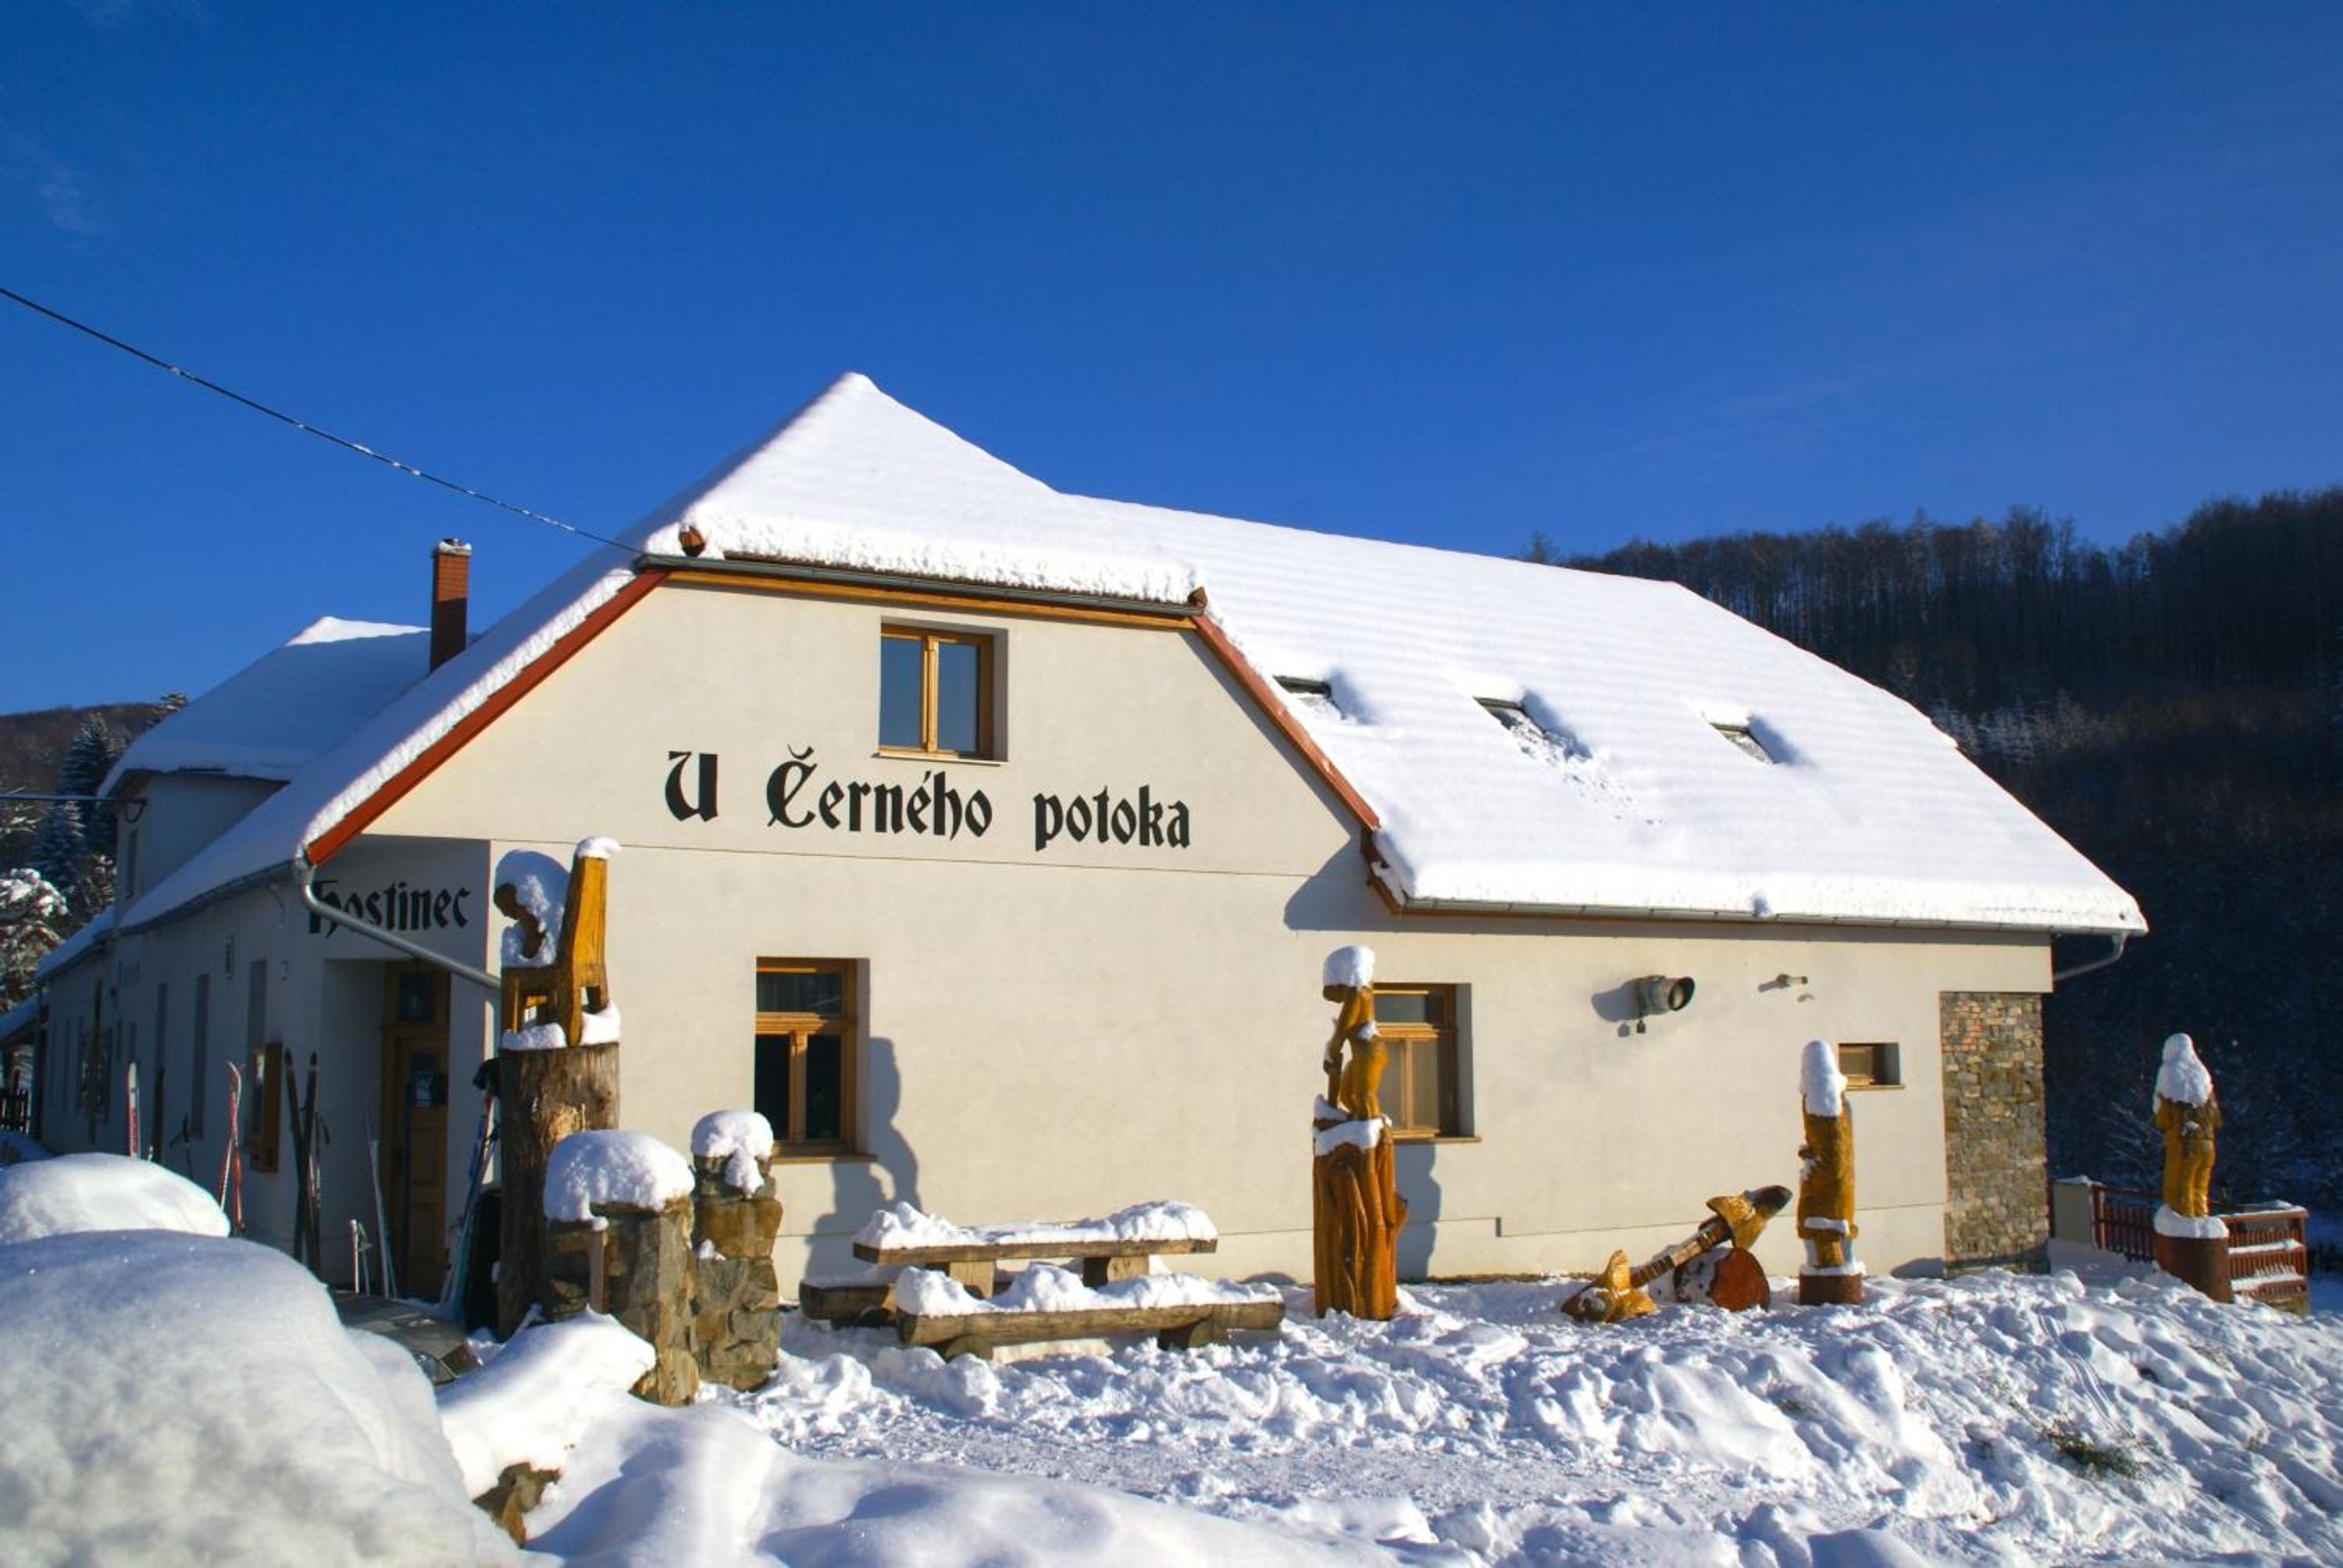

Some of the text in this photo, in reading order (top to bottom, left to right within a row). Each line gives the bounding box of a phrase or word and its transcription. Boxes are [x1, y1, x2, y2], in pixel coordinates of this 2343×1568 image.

[665, 744, 1191, 853] U Černého potoka
[308, 879, 473, 938] Hostinec
